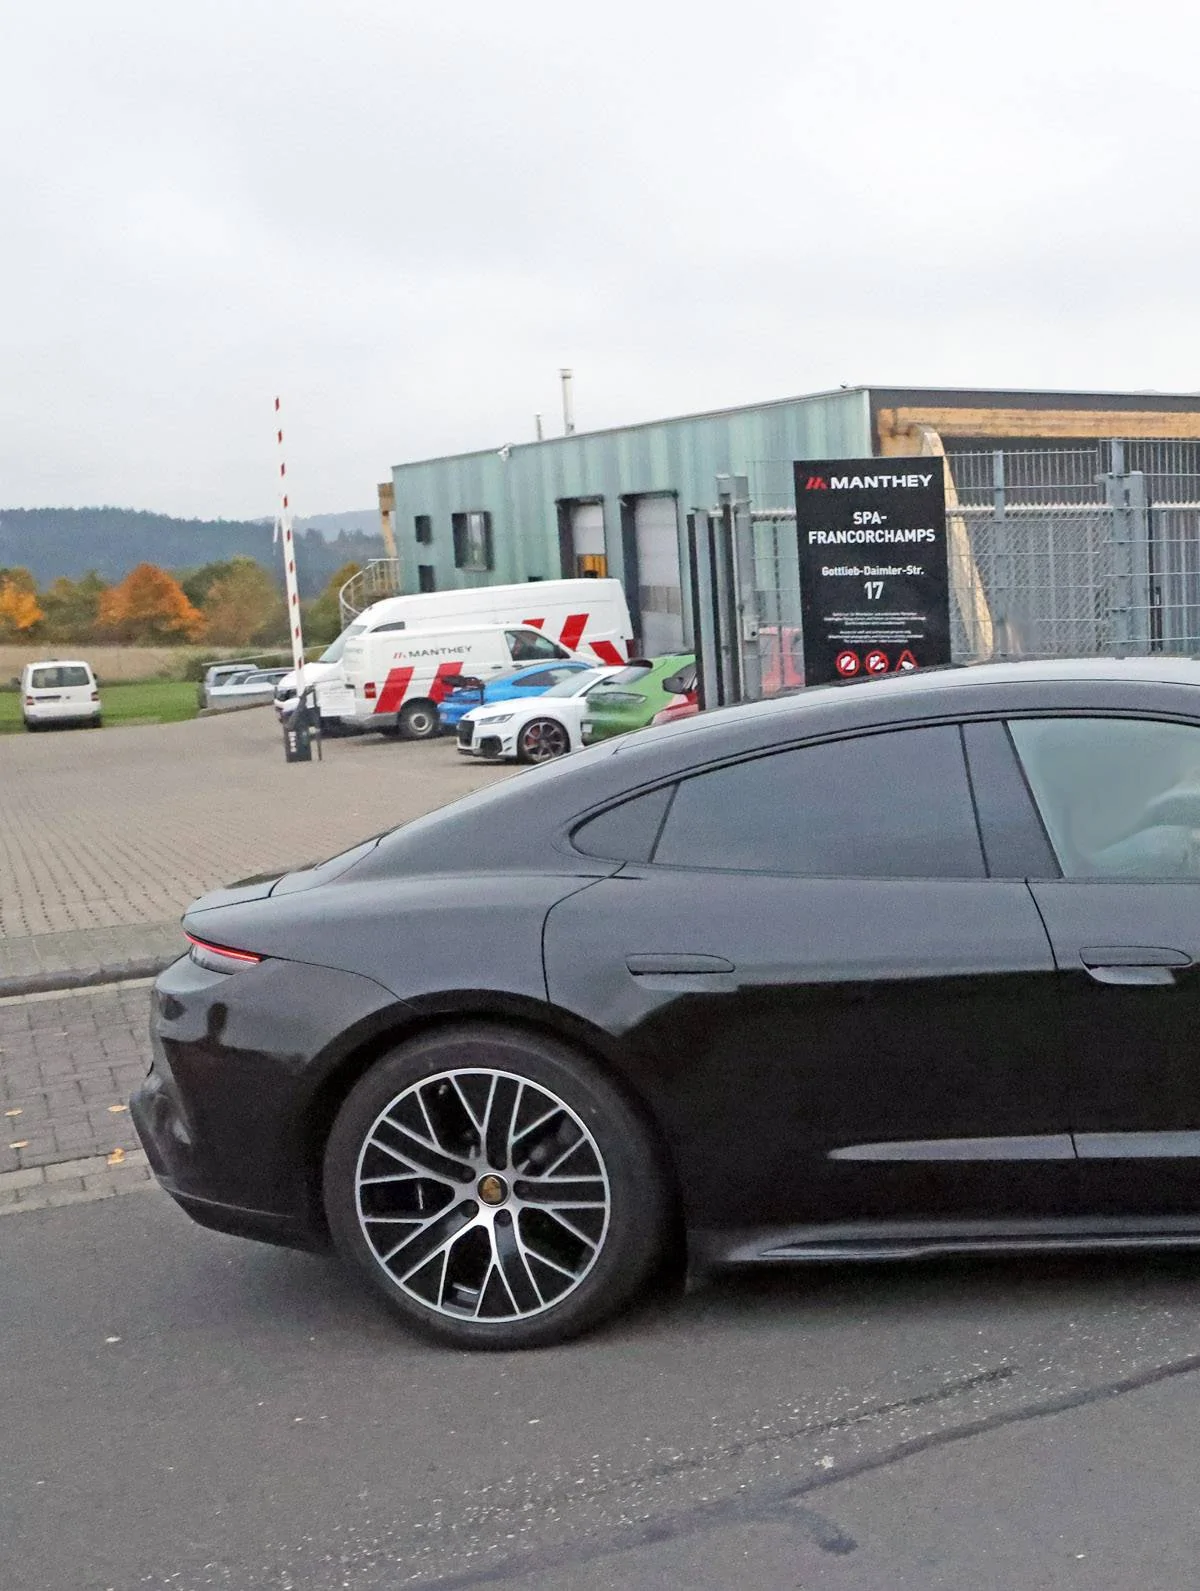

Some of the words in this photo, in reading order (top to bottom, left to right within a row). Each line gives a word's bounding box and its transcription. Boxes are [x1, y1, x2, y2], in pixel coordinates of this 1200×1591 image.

[831, 475, 932, 489] MANTHEY
[853, 512, 887, 525] SPA-
[808, 529, 936, 545] FRANCORCHAMPS
[822, 565, 925, 577] Gottlieb-Daimler-Str.
[864, 582, 884, 600] 17
[409, 646, 472, 657] MANTHEY
